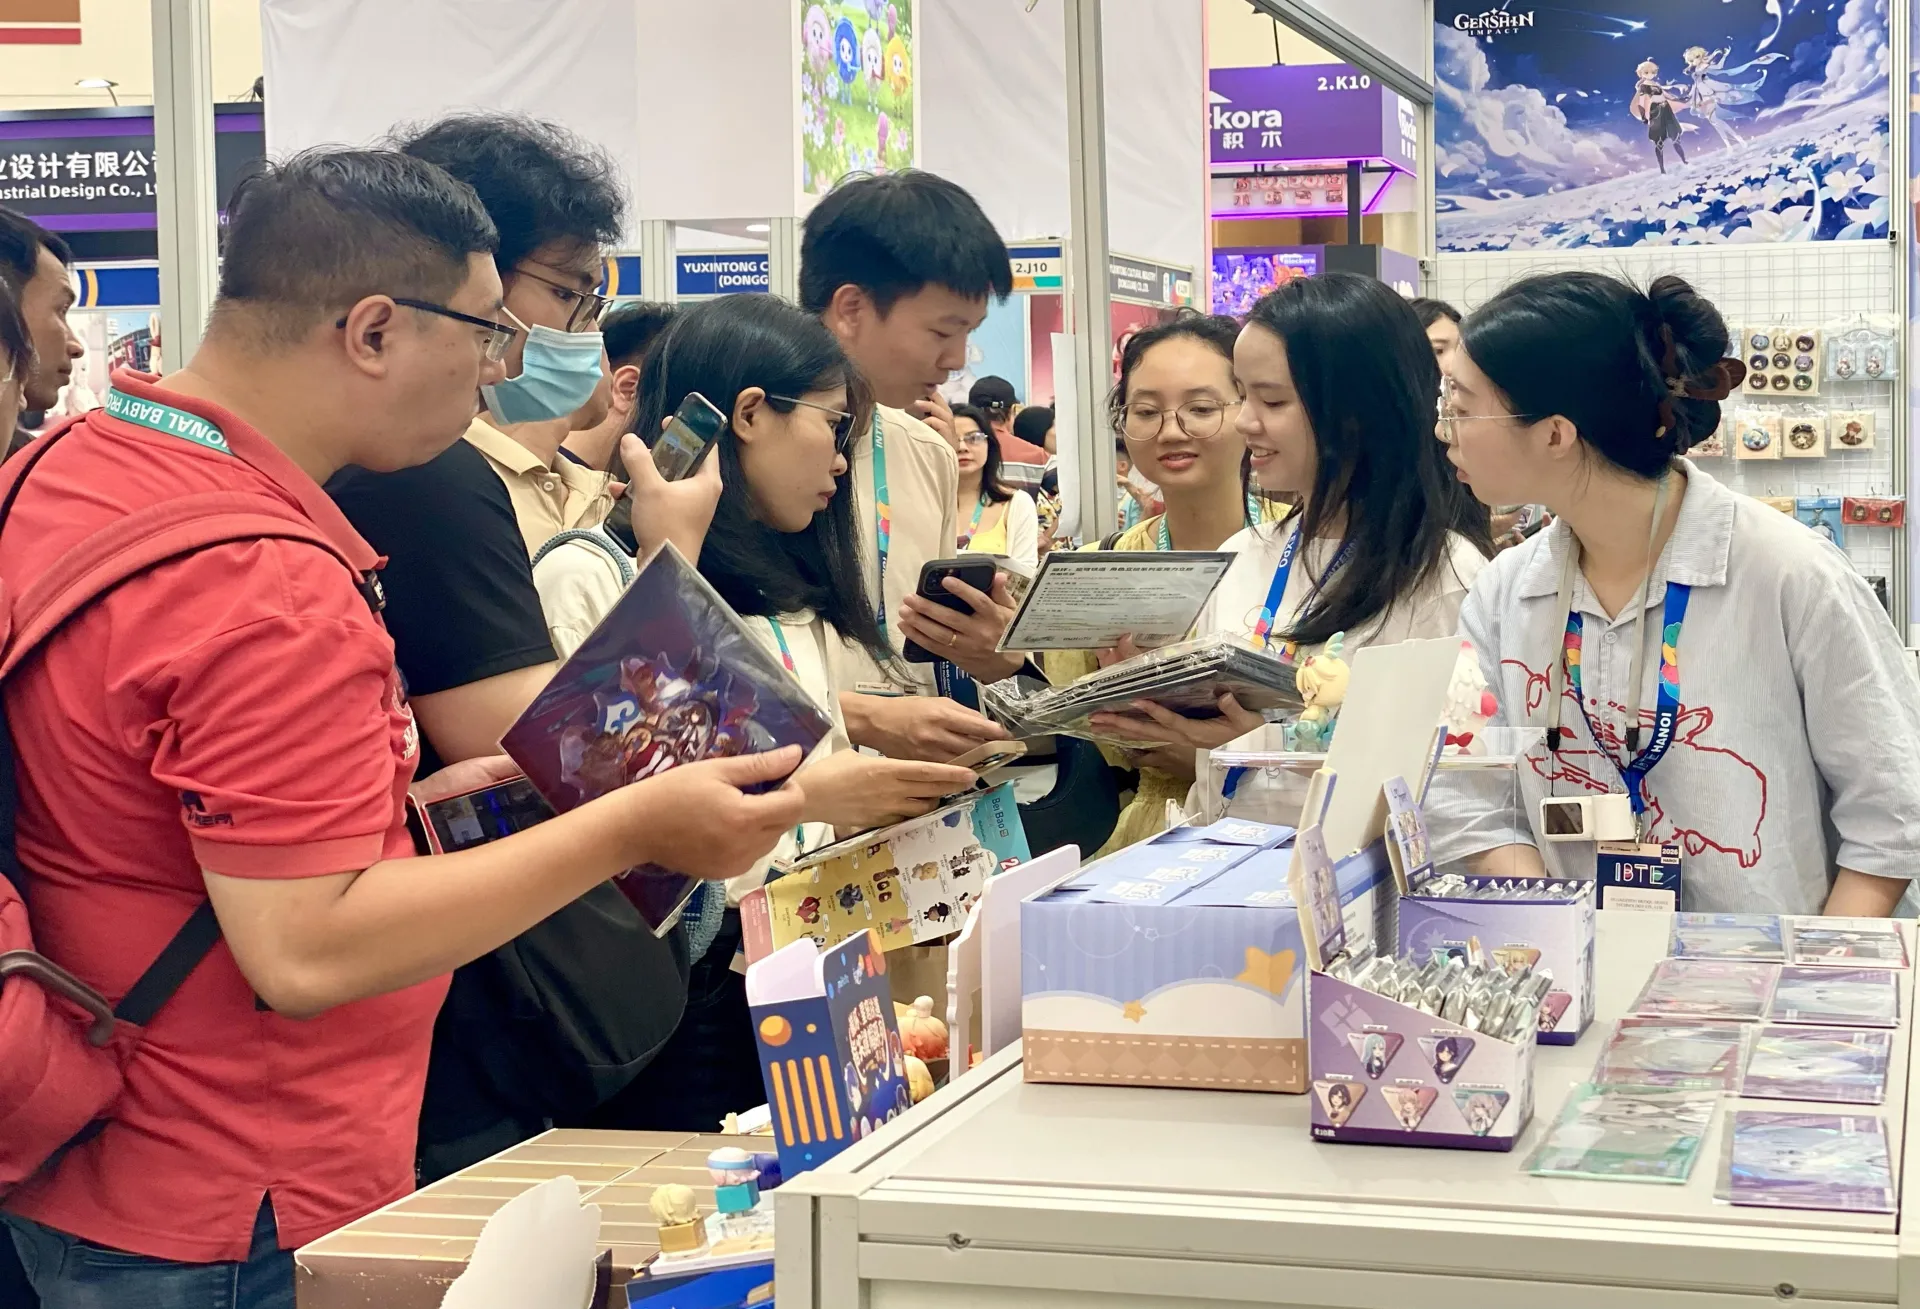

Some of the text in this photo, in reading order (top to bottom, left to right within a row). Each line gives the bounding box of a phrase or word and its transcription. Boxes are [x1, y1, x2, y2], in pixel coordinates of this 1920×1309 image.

[1453, 10, 1535, 30] GENSHIN
[1470, 28, 1519, 36] IMPACT
[1317, 75, 1371, 91] 2.K10
[1210, 106, 1283, 129] kora
[0, 150, 157, 181] 设计有限公
[49, 182, 106, 200] Design
[109, 183, 142, 198] Co.,
[683, 261, 757, 274] YUXINTONG
[1015, 262, 1048, 274] 2.J10
[121, 400, 165, 425] BABY
[1650, 712, 1672, 752] HANOI
[995, 811, 1005, 829] Bao
[1614, 862, 1665, 885] IBTE
